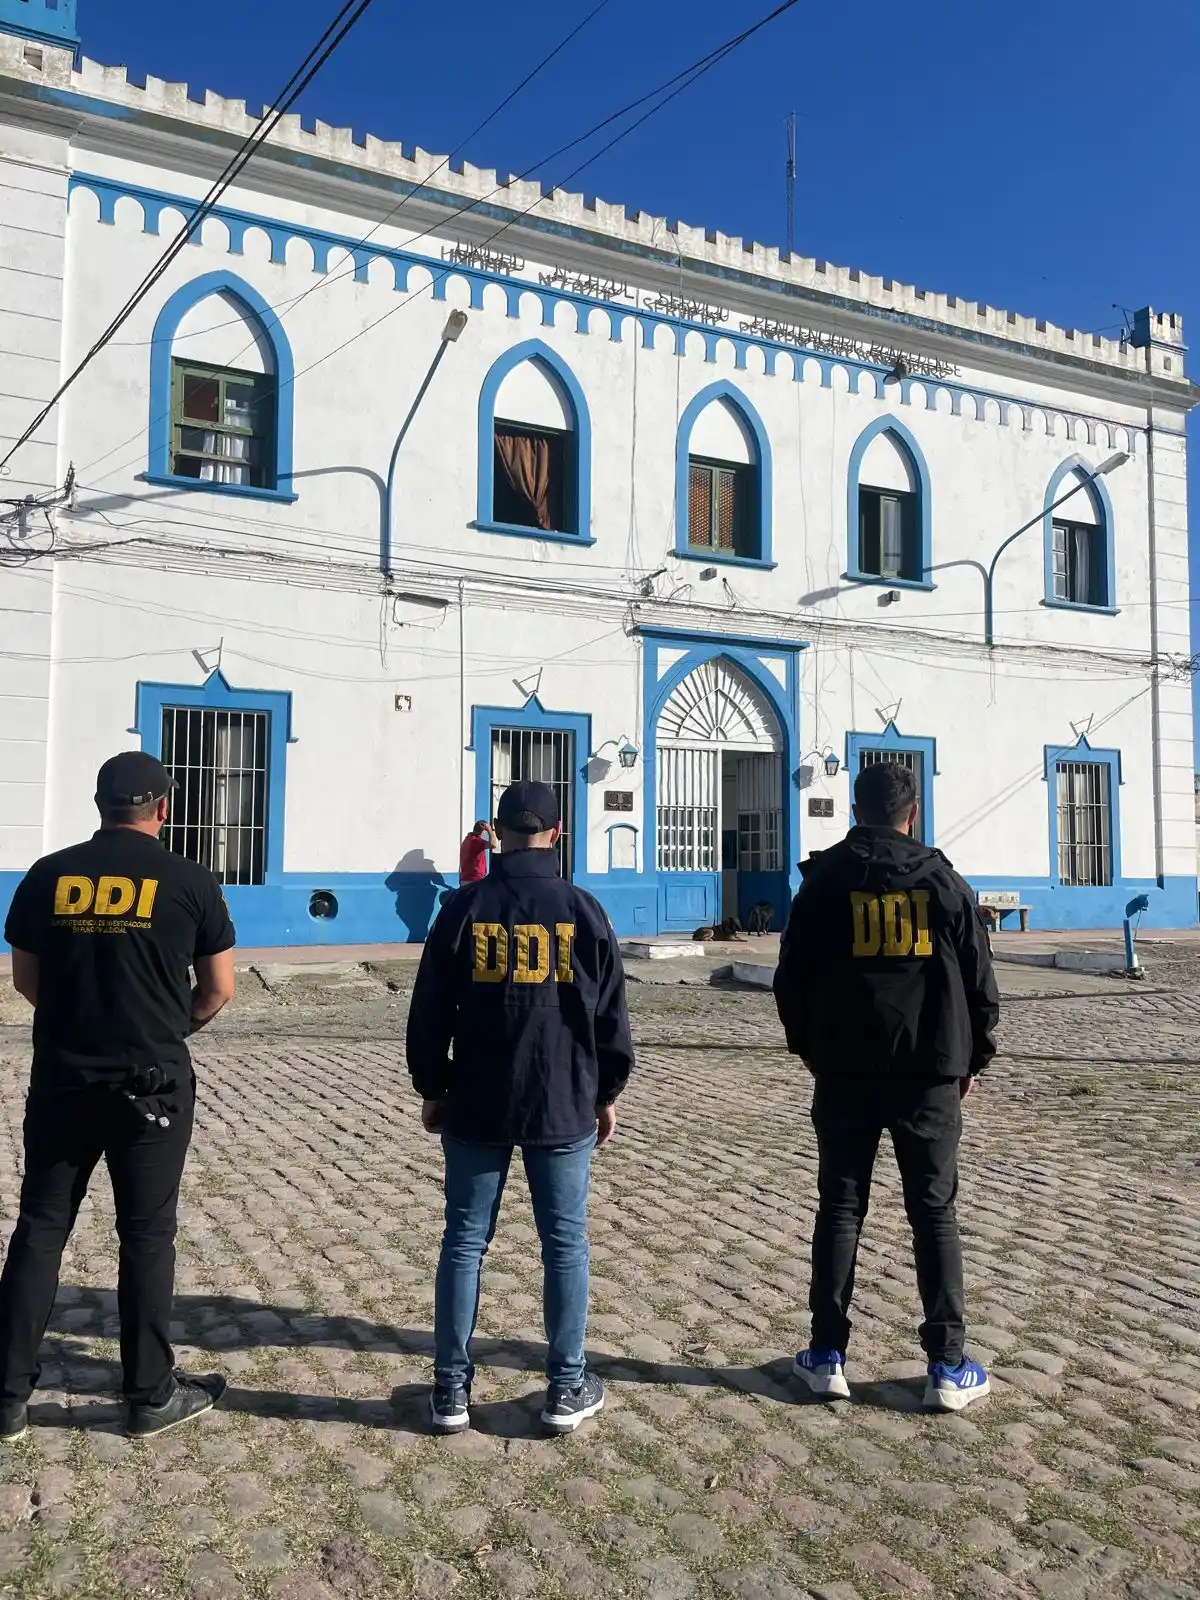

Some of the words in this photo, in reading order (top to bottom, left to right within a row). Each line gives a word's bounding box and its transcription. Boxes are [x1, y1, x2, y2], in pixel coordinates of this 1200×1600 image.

[53, 875, 159, 919] DDI
[850, 889, 933, 956] DDI
[472, 922, 575, 984] DDI
